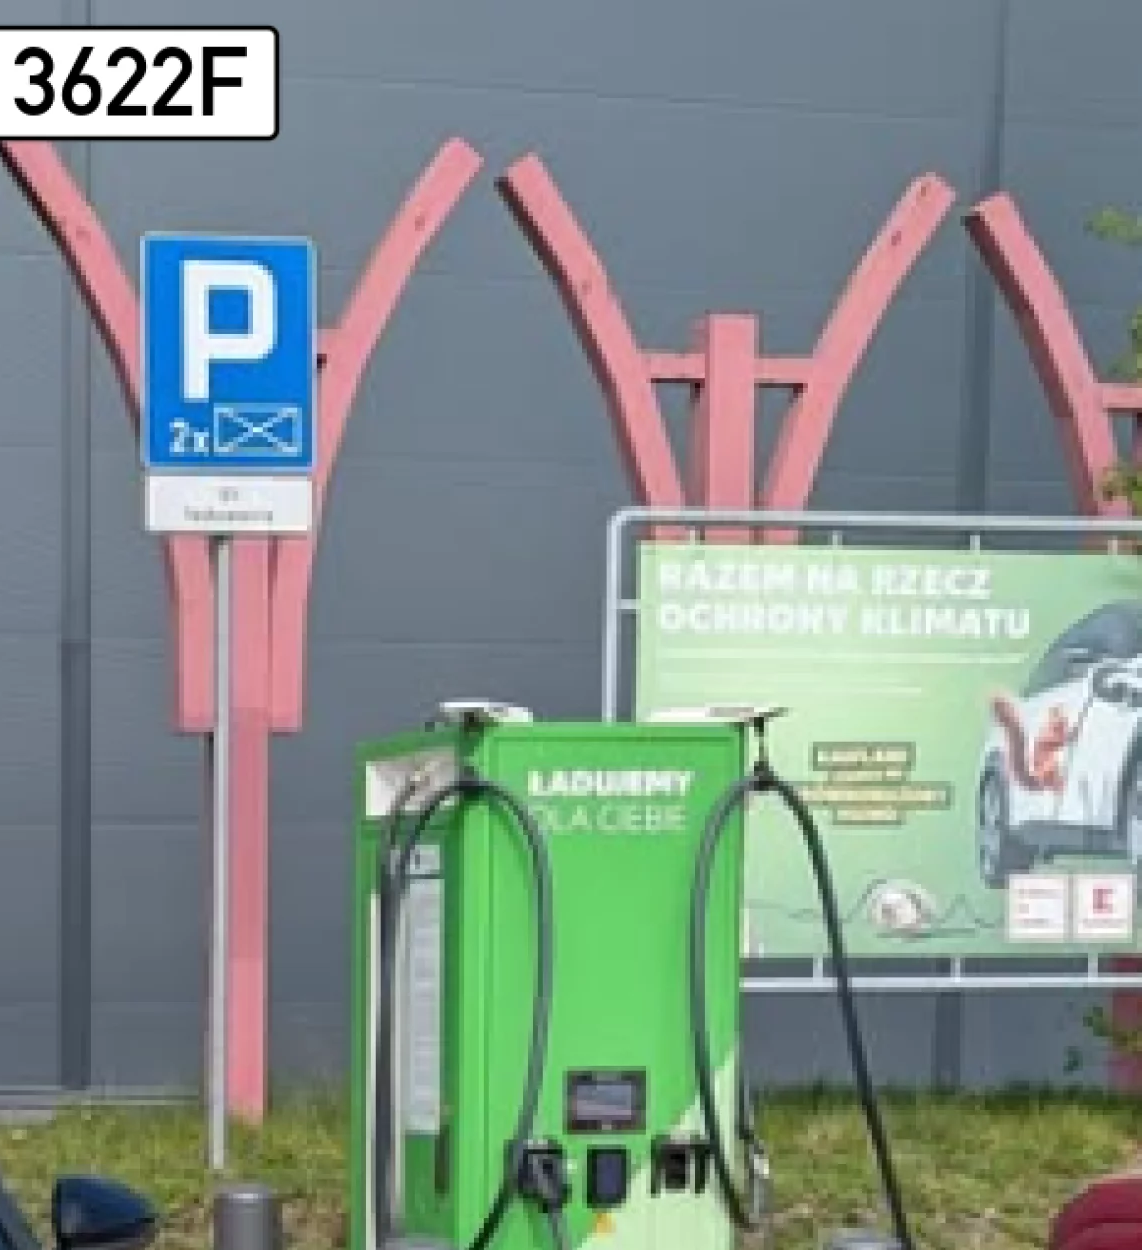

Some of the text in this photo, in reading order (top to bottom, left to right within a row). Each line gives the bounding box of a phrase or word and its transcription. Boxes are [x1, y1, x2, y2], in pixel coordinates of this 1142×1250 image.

[179, 260, 278, 403] P
[658, 562, 994, 600] RAZEM NA RZECZ
[659, 603, 1031, 640] OCHRONY KLIMATU
